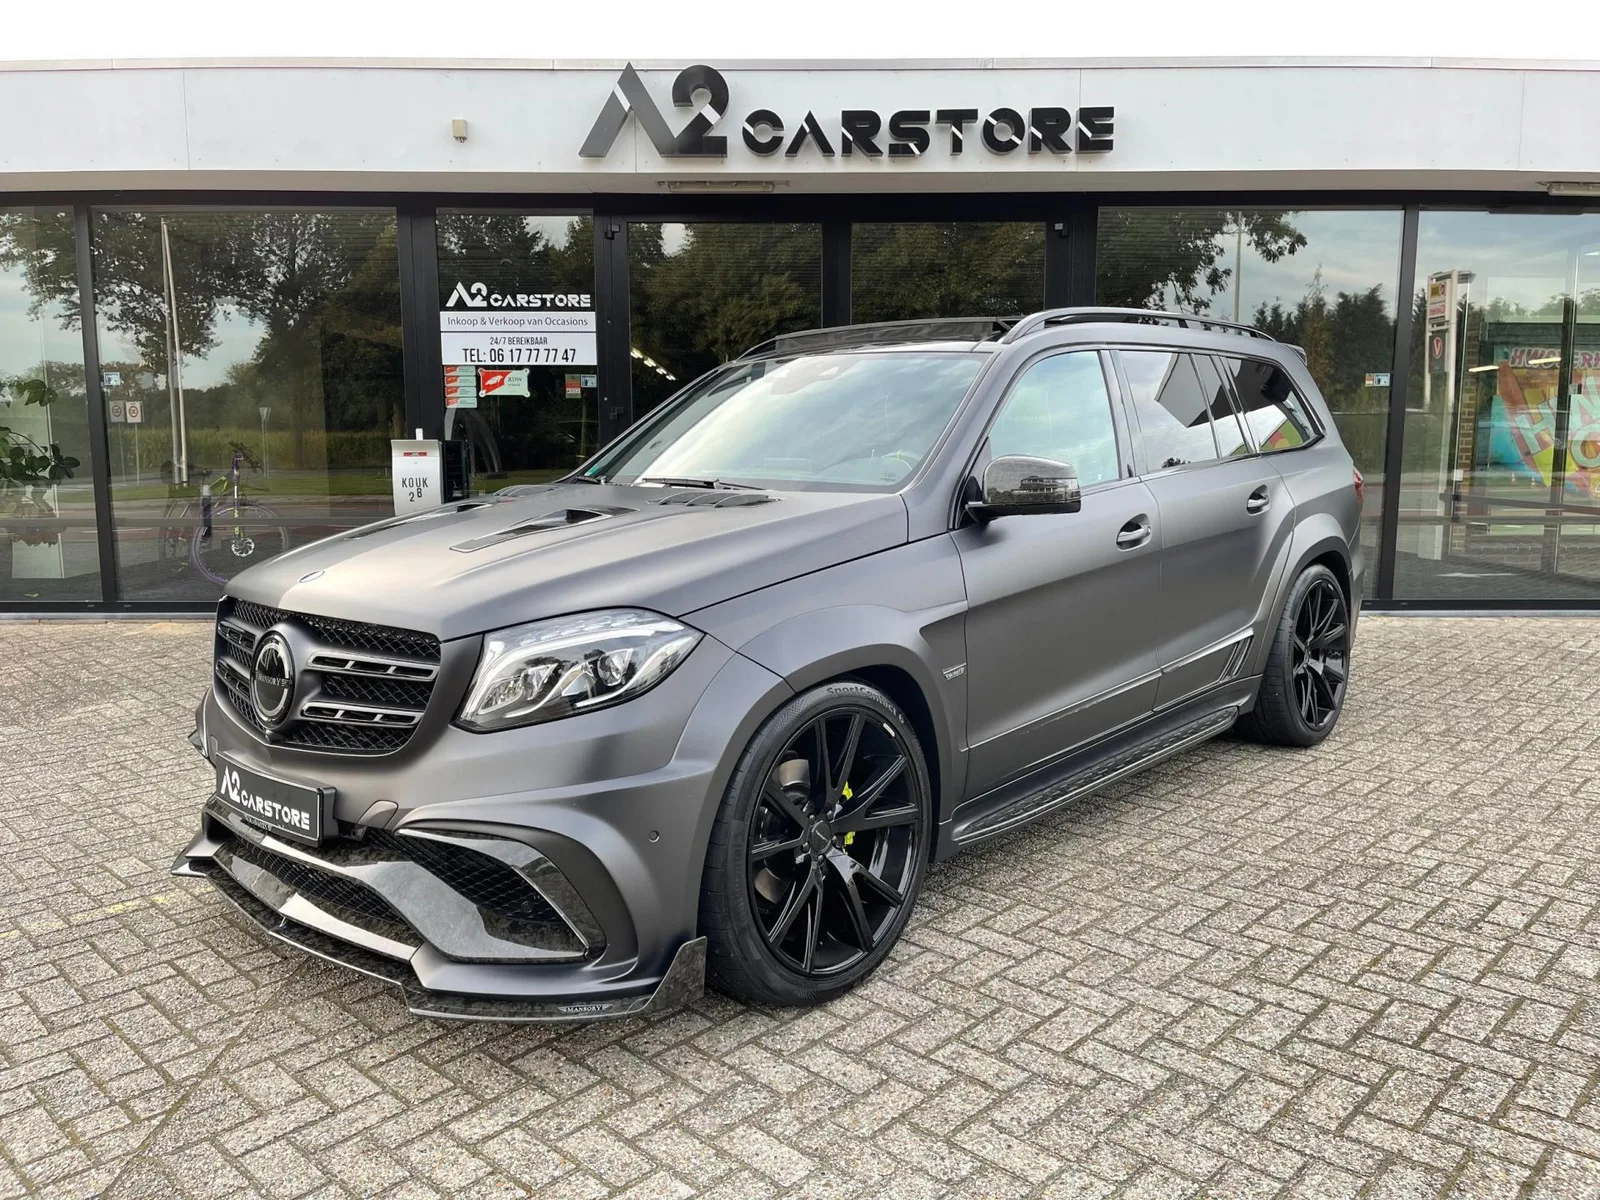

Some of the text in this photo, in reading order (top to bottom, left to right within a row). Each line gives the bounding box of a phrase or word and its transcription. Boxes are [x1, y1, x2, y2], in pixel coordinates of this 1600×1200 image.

[578, 60, 1115, 158] A2 CARSTORE
[445, 281, 591, 307] A2 CARSTORE
[447, 316, 588, 327] Inkoop & Verkoop van Occasions
[489, 336, 548, 345] 24/7 BEREIKBAAR
[462, 348, 576, 363] TEL: 06 17 77 77 47
[402, 477, 429, 488] KOUK
[826, 685, 905, 724] SportContact 6
[220, 765, 241, 804] A2
[240, 789, 310, 831] CARSTORE
